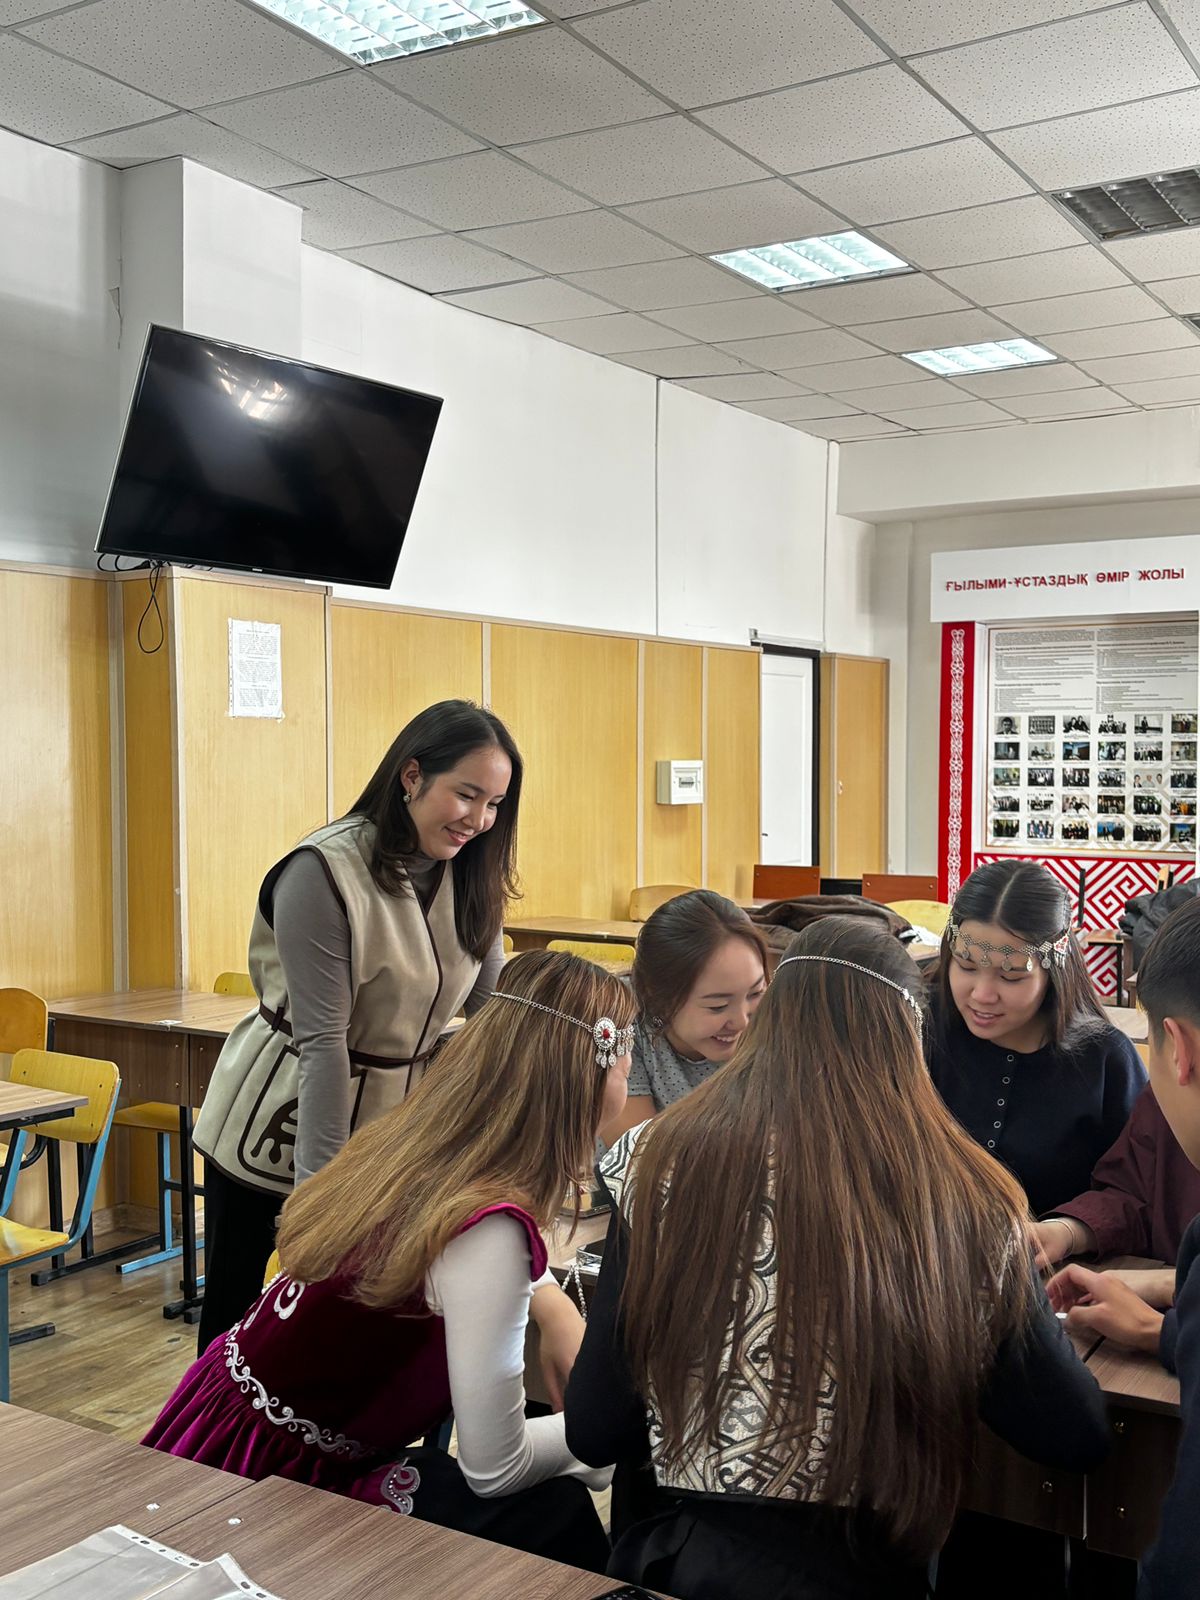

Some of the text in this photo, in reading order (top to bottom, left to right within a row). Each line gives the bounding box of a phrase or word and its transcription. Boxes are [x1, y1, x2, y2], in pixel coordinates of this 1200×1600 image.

[945, 568, 1185, 592] ҒЫЛЫМИ-ҰСТАЗДЫҚ ӨМІР ЖОЛЫ
